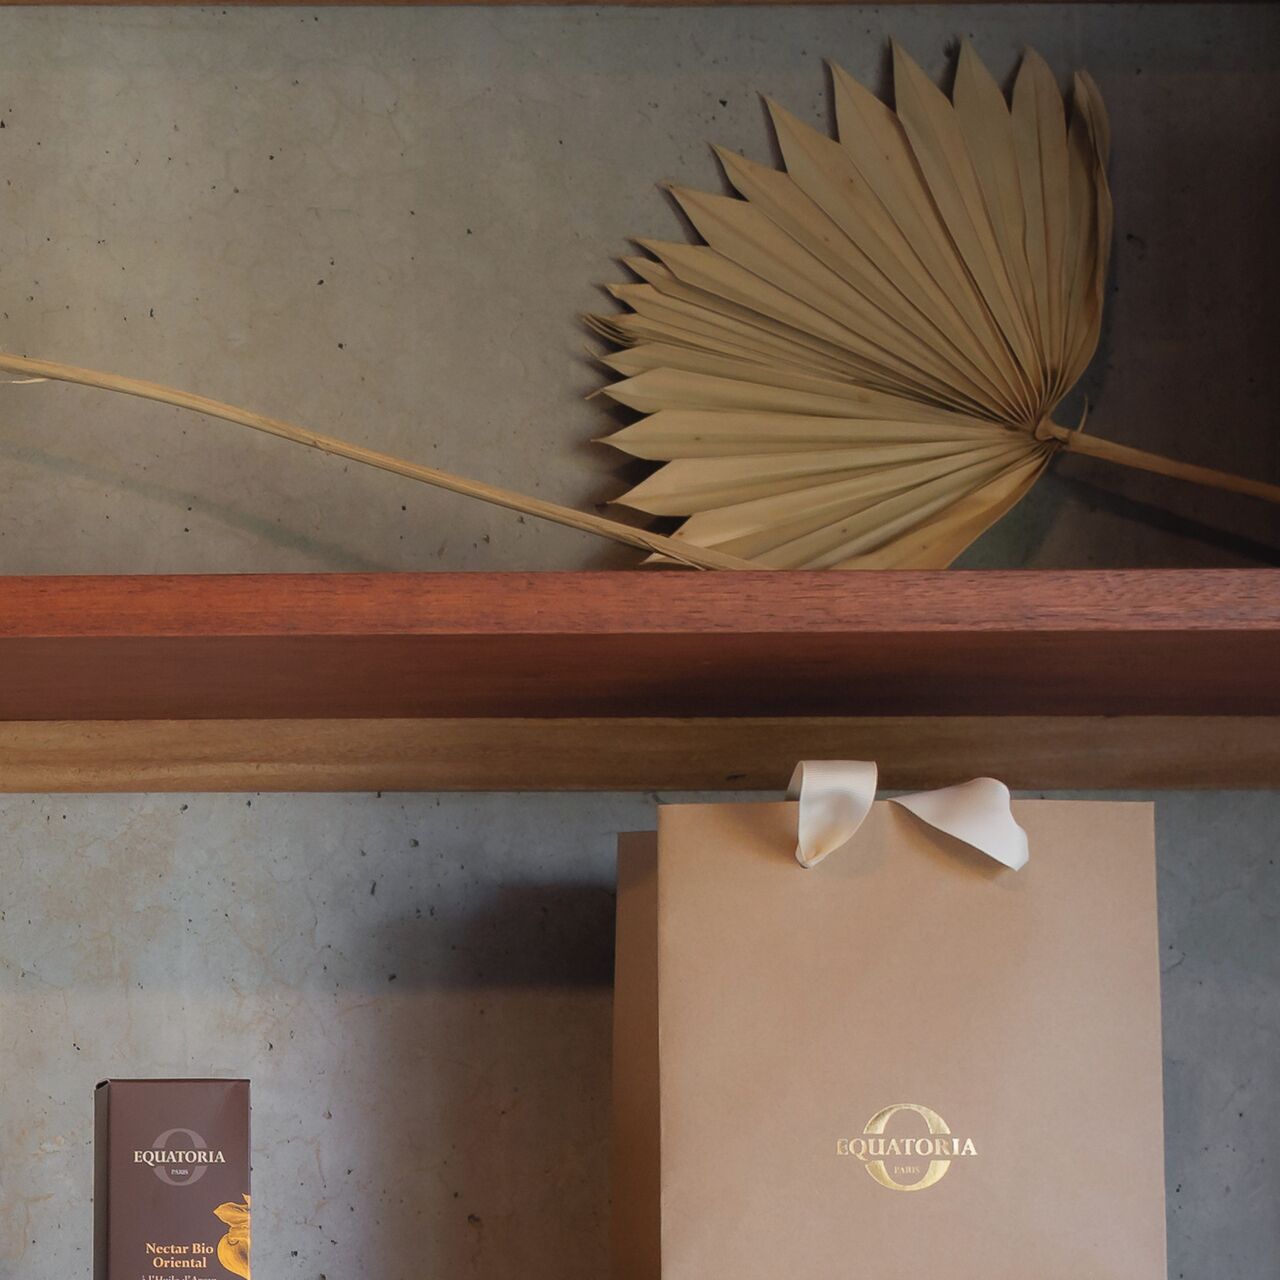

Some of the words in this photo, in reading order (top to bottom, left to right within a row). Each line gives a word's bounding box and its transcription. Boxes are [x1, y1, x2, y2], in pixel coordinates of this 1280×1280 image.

[837, 1137, 978, 1161] EQUATORIA
[134, 1151, 225, 1167] EQUATORIA
[894, 1166, 920, 1174] PARIS
[146, 1243, 189, 1254] Nectar
[192, 1243, 213, 1254] Bio
[153, 1257, 206, 1268] Oriental
